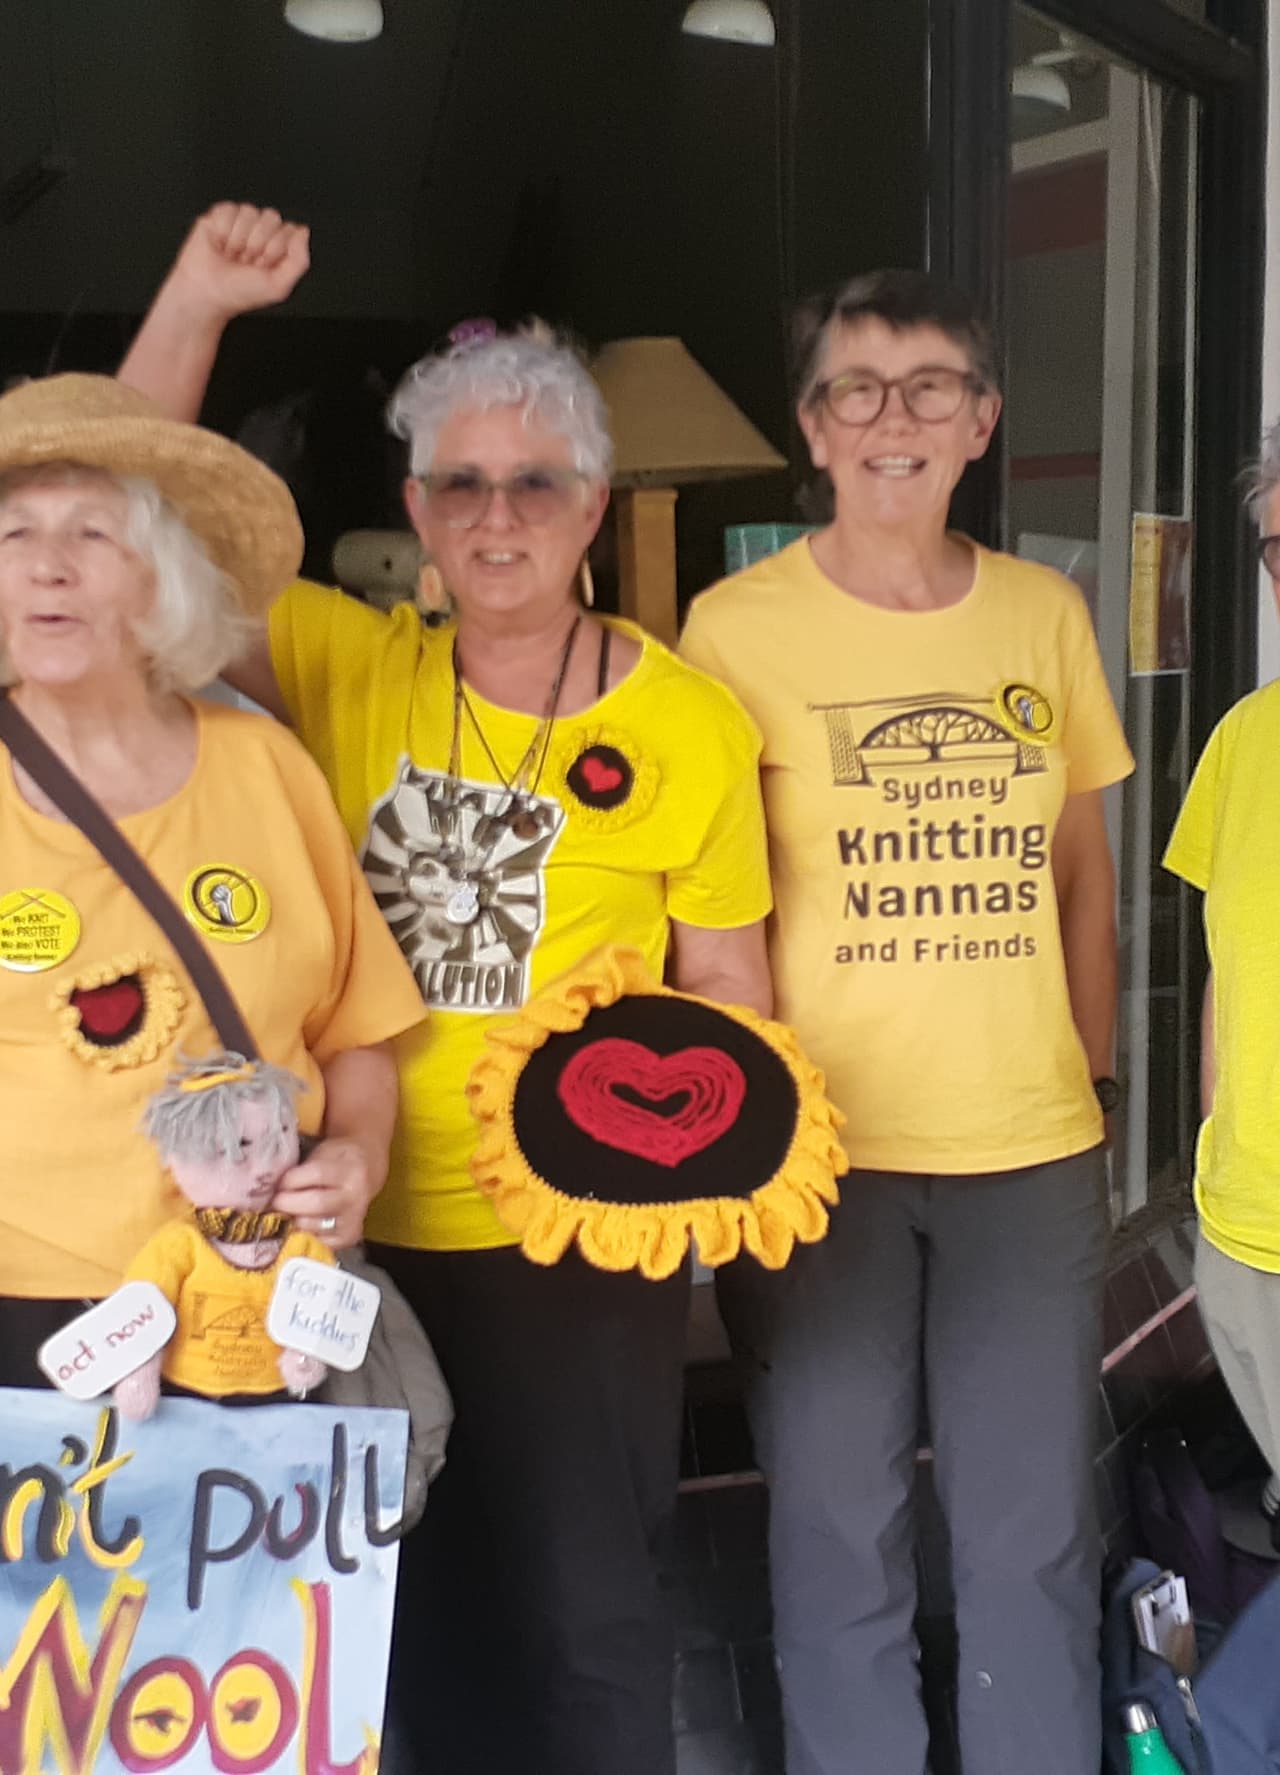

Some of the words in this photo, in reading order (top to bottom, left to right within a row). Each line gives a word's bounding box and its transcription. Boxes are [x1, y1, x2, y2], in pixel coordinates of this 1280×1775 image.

[883, 776, 1008, 809] Sydney
[837, 814, 1046, 870] Knitting
[844, 879, 1039, 920] Nannas
[17, 925, 60, 937] PROTEST
[35, 938, 61, 949] VOTE
[835, 938, 897, 964] and
[914, 933, 1037, 962] Friends
[336, 1279, 365, 1312] the
[58, 1340, 96, 1380] act
[105, 1304, 154, 1348] now
[190, 1421, 410, 1611] pull
